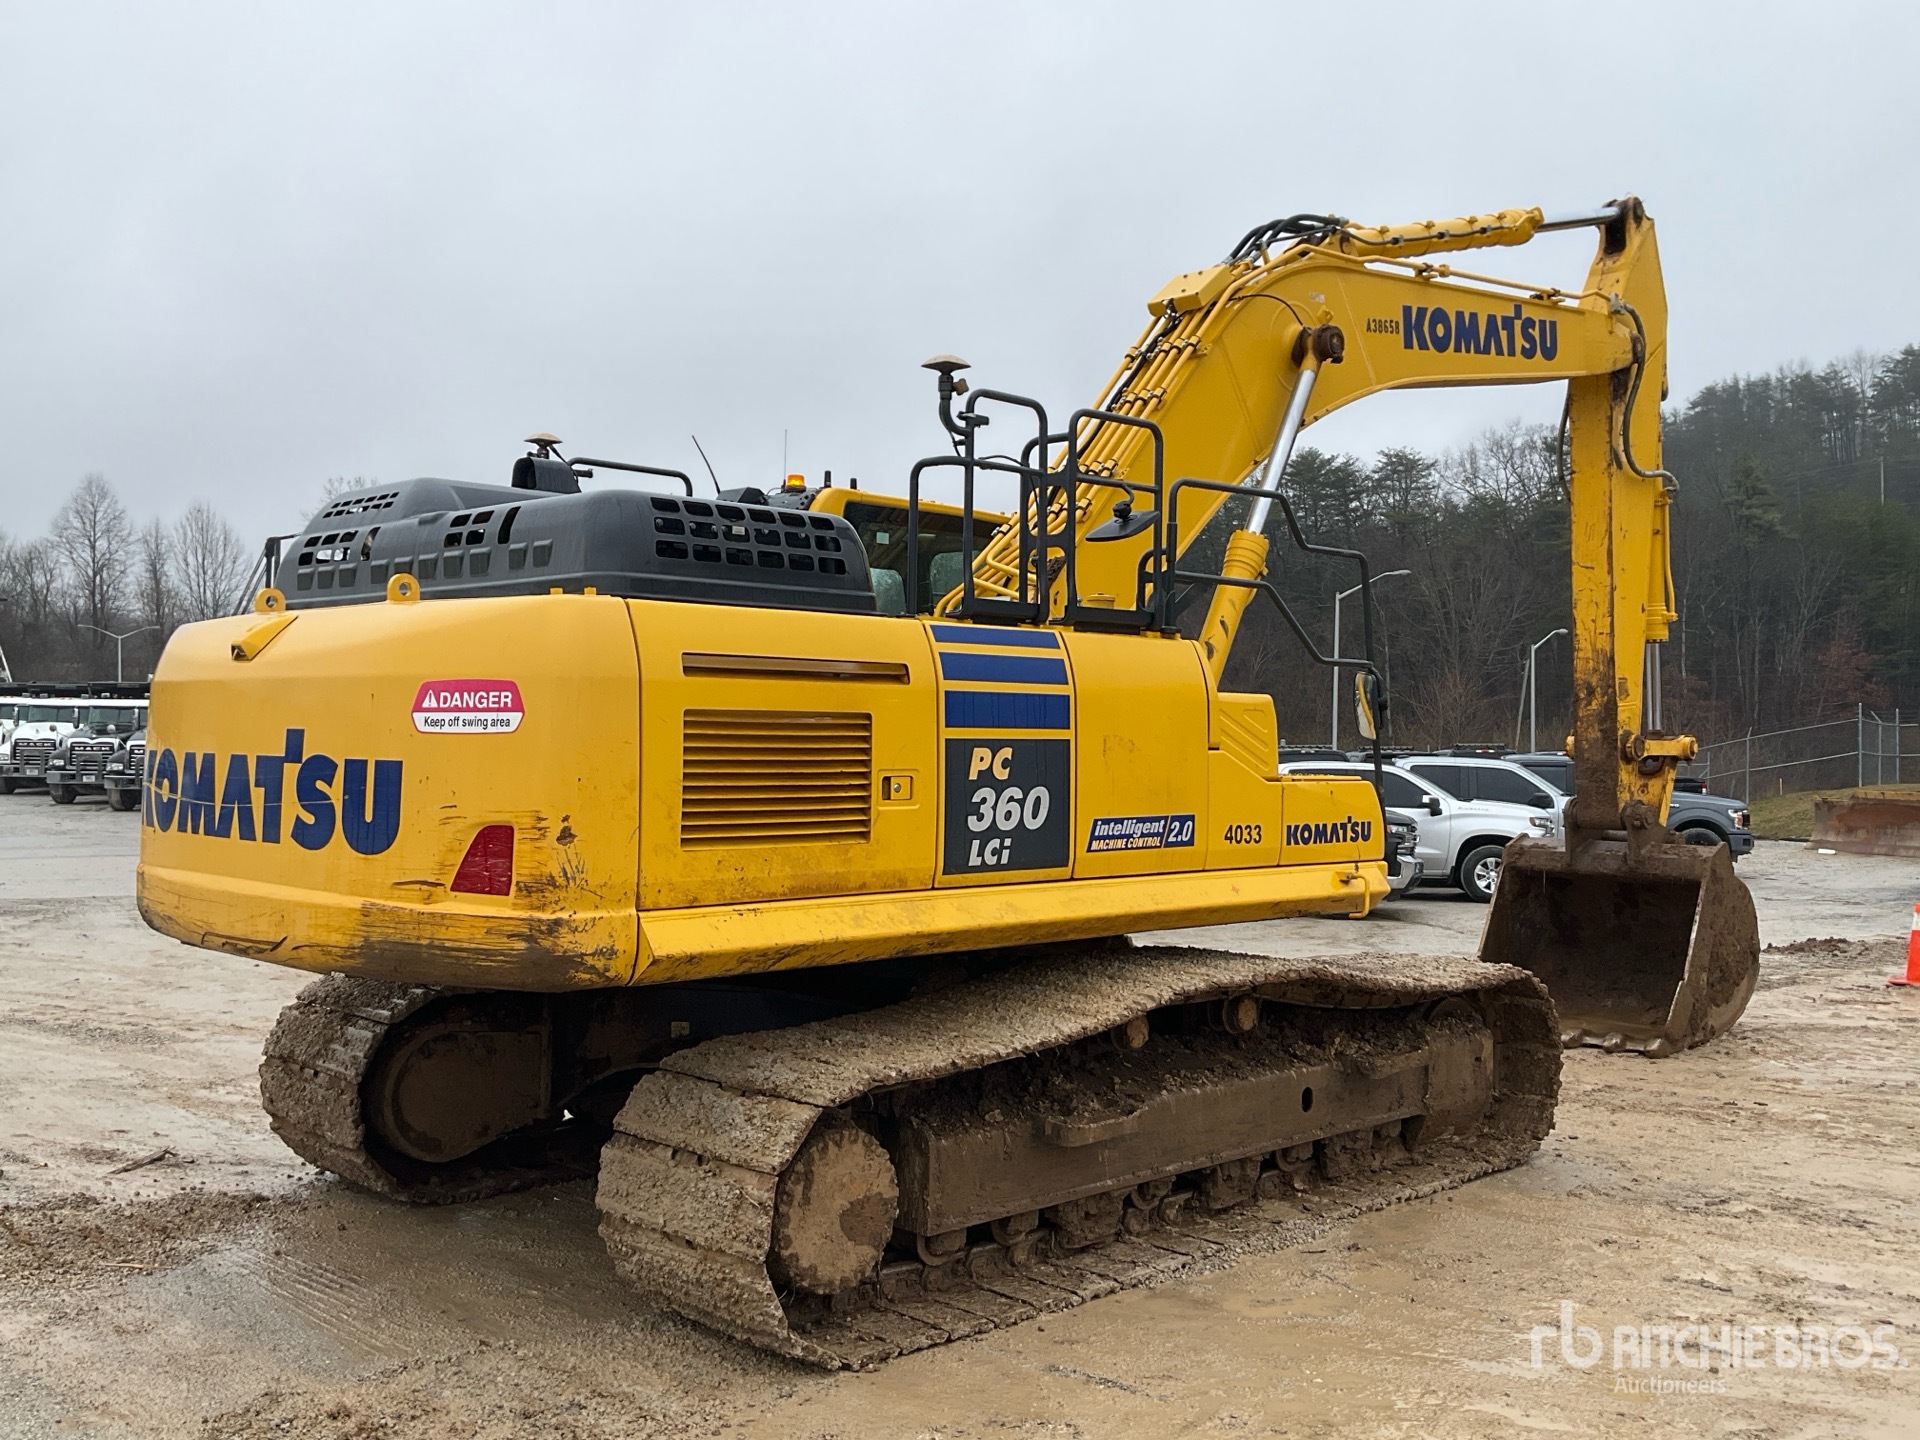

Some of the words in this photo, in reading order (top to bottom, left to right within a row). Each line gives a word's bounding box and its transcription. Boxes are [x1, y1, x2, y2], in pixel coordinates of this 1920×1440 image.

[1402, 304, 1558, 361] KOMATSU
[440, 691, 513, 708] DANGER
[424, 716, 445, 729] Keep
[448, 716, 460, 727] off
[462, 716, 489, 730] swing
[490, 717, 511, 728] area
[968, 747, 1013, 780] PC
[967, 786, 1050, 832] 360
[1094, 818, 1165, 838] intelligent
[1167, 820, 1193, 842] 2.0
[1224, 824, 1262, 845] 4033
[1286, 815, 1372, 846] KOMATSU
[968, 838, 1012, 867] LCi
[1091, 840, 1126, 850] MACHINE
[1127, 836, 1161, 848] CONTROL
